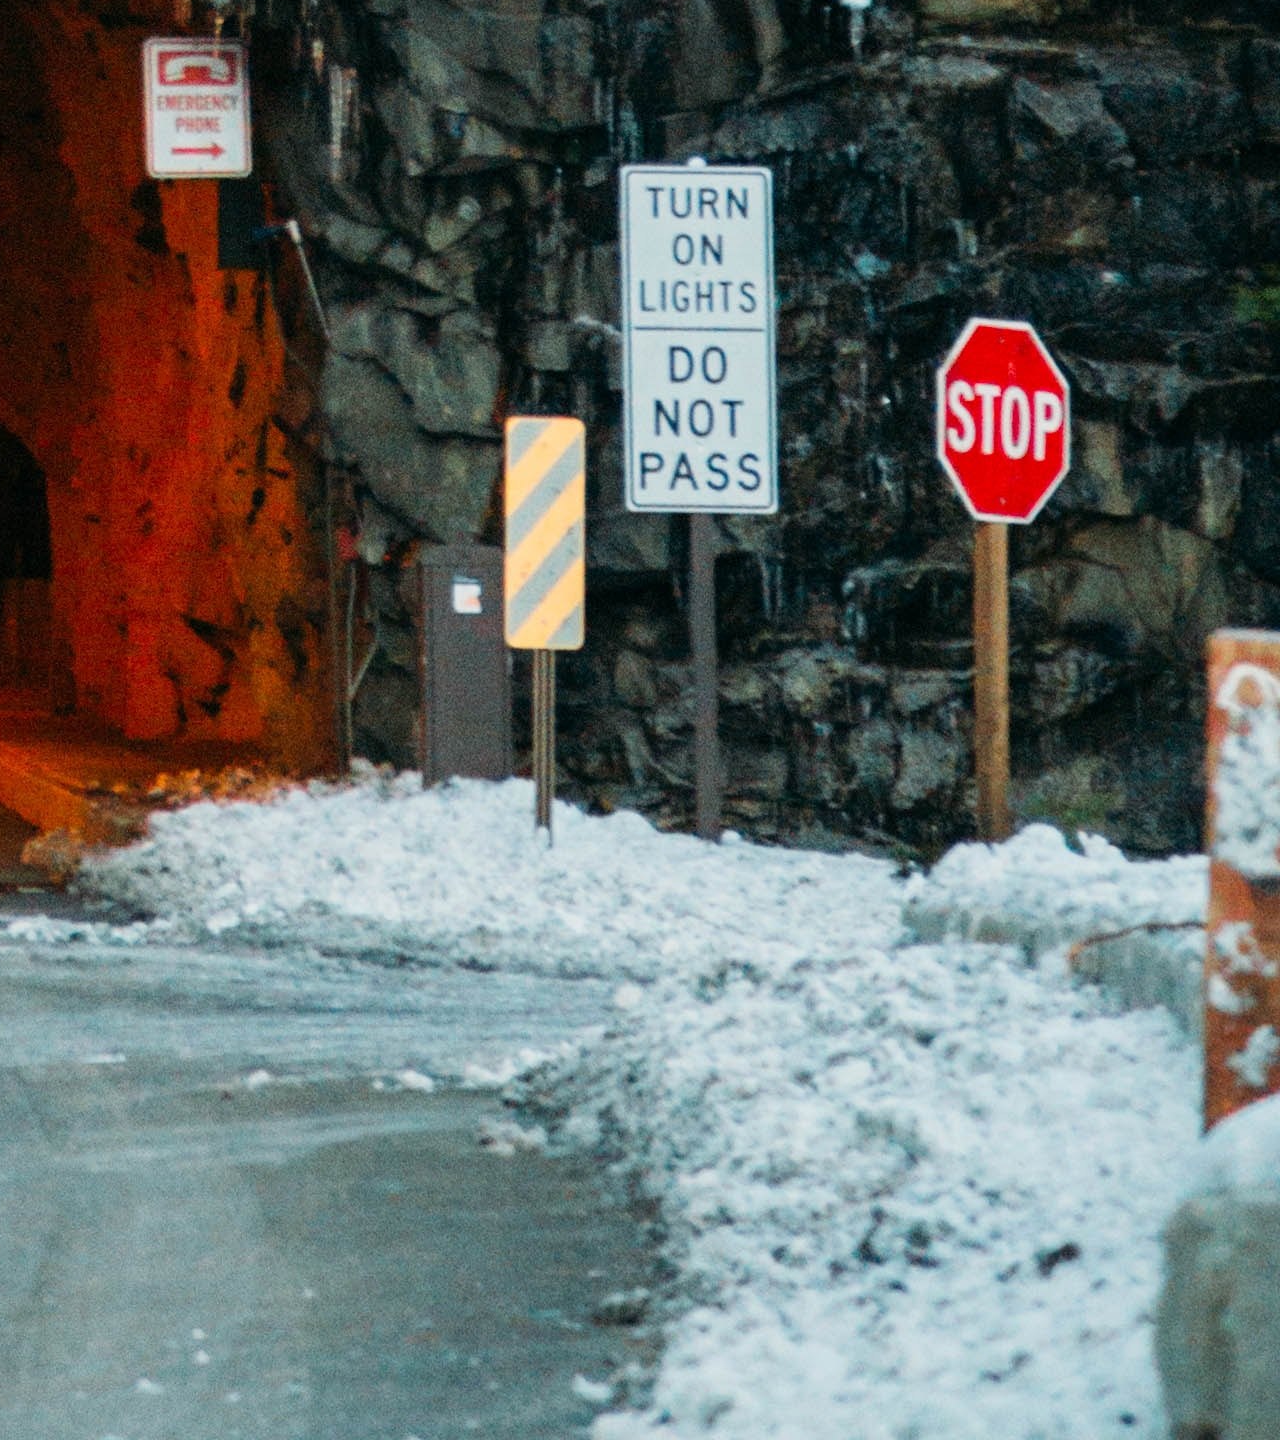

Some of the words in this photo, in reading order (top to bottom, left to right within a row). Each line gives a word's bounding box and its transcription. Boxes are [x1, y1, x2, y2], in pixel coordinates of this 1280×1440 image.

[157, 95, 238, 111] EMERGENCY
[175, 117, 221, 133] PHONE
[646, 187, 748, 219] TURN
[673, 233, 723, 266] ON
[640, 281, 757, 313] LIGHTS
[669, 346, 727, 384] DO
[653, 399, 744, 437] NOT
[947, 380, 1063, 462] STOP
[640, 452, 761, 491] PASS
